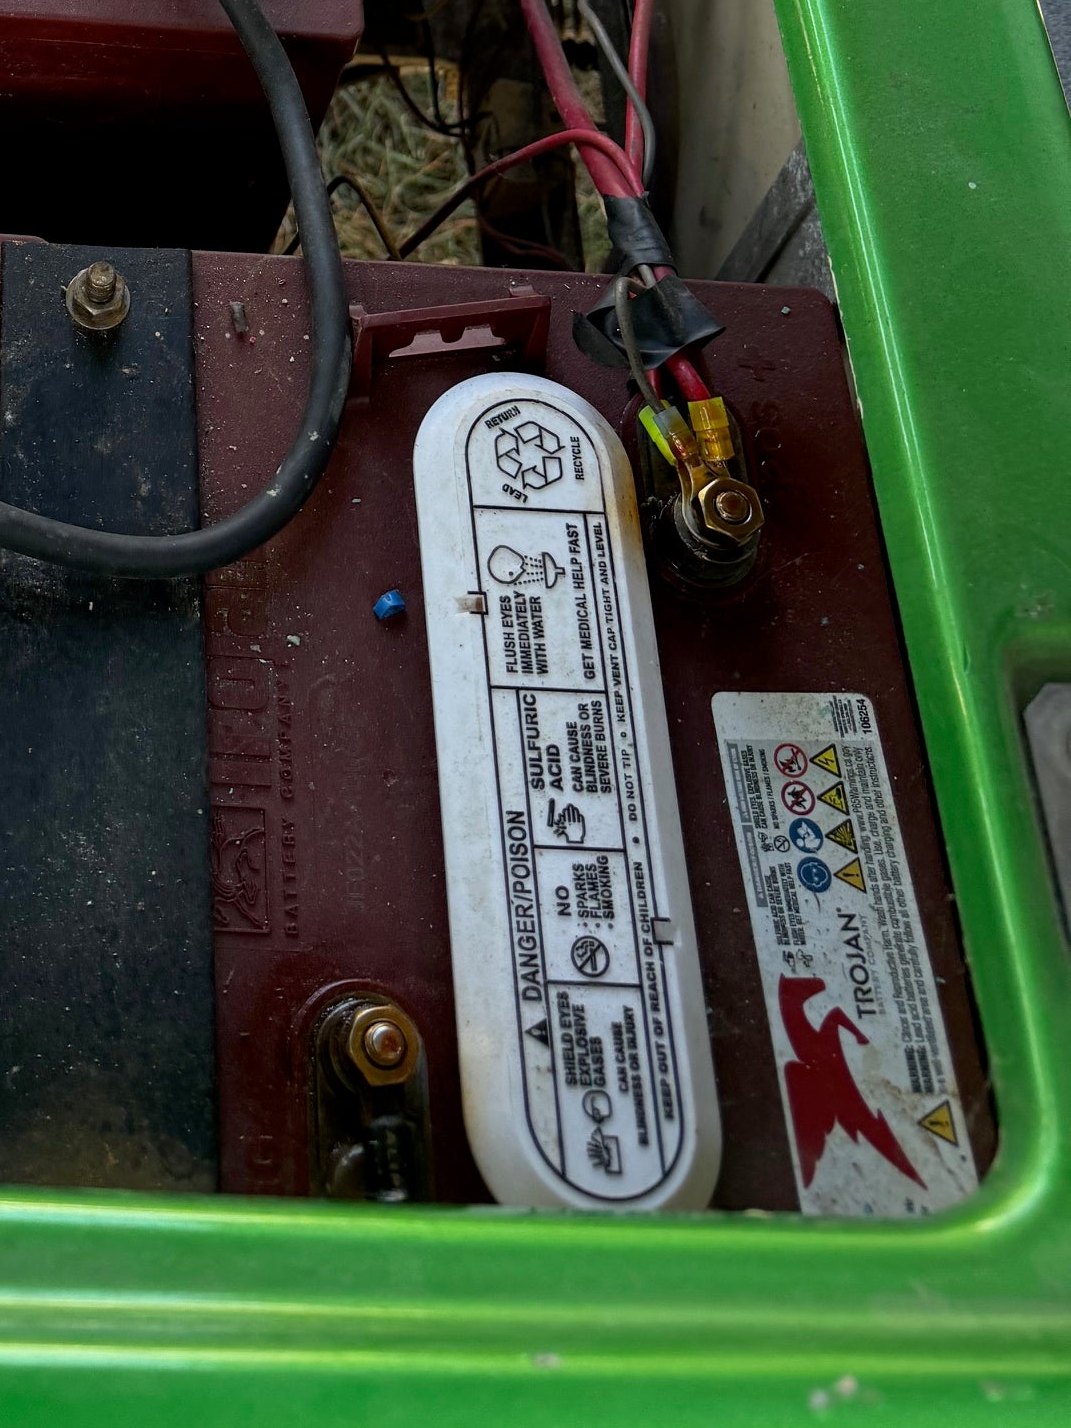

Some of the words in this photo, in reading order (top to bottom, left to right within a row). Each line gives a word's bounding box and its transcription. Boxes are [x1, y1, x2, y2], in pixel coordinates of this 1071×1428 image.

[484, 405, 521, 430] RETURN
[571, 436, 585, 480] RECYCLE
[502, 483, 528, 503] LEAD
[565, 522, 581, 554] FAST
[592, 521, 605, 557] LEVEL
[569, 556, 585, 589] HELP
[597, 560, 609, 585] AND
[498, 595, 514, 628] EYES
[528, 595, 545, 639] WATER
[574, 592, 592, 650] MEDICAL
[601, 587, 614, 623] TIGHT
[512, 590, 534, 674] IMMEDIATELY
[606, 626, 617, 651] CAP
[502, 631, 518, 673] FLUSH
[533, 643, 549, 674] WITH
[581, 652, 596, 680] GET
[609, 653, 622, 687] VENT
[577, 702, 590, 720] OR
[590, 699, 606, 741] BURNS
[613, 689, 626, 722] KEEP
[855, 699, 873, 733] 106254
[522, 693, 545, 790] SULFURIC
[565, 721, 581, 763] CAUSE
[579, 723, 598, 793] BLINDNESS
[620, 748, 631, 769] TIP
[545, 743, 564, 792] ACID
[570, 766, 584, 792] CAN
[595, 744, 612, 793] SEVERE
[623, 774, 635, 799] NOT
[627, 803, 637, 821] DO
[282, 818, 300, 936] BATTERY
[572, 863, 590, 918] SPARKS
[584, 863, 602, 919] FLAMES
[596, 855, 615, 920] SMOKING
[505, 810, 543, 1002] DANGER/POISON
[554, 885, 572, 916] NO
[556, 991, 572, 1029] EYES
[560, 1032, 578, 1086] SHIELD
[571, 1005, 593, 1086] EXPLOSIVE
[588, 1036, 606, 1086] GASES
